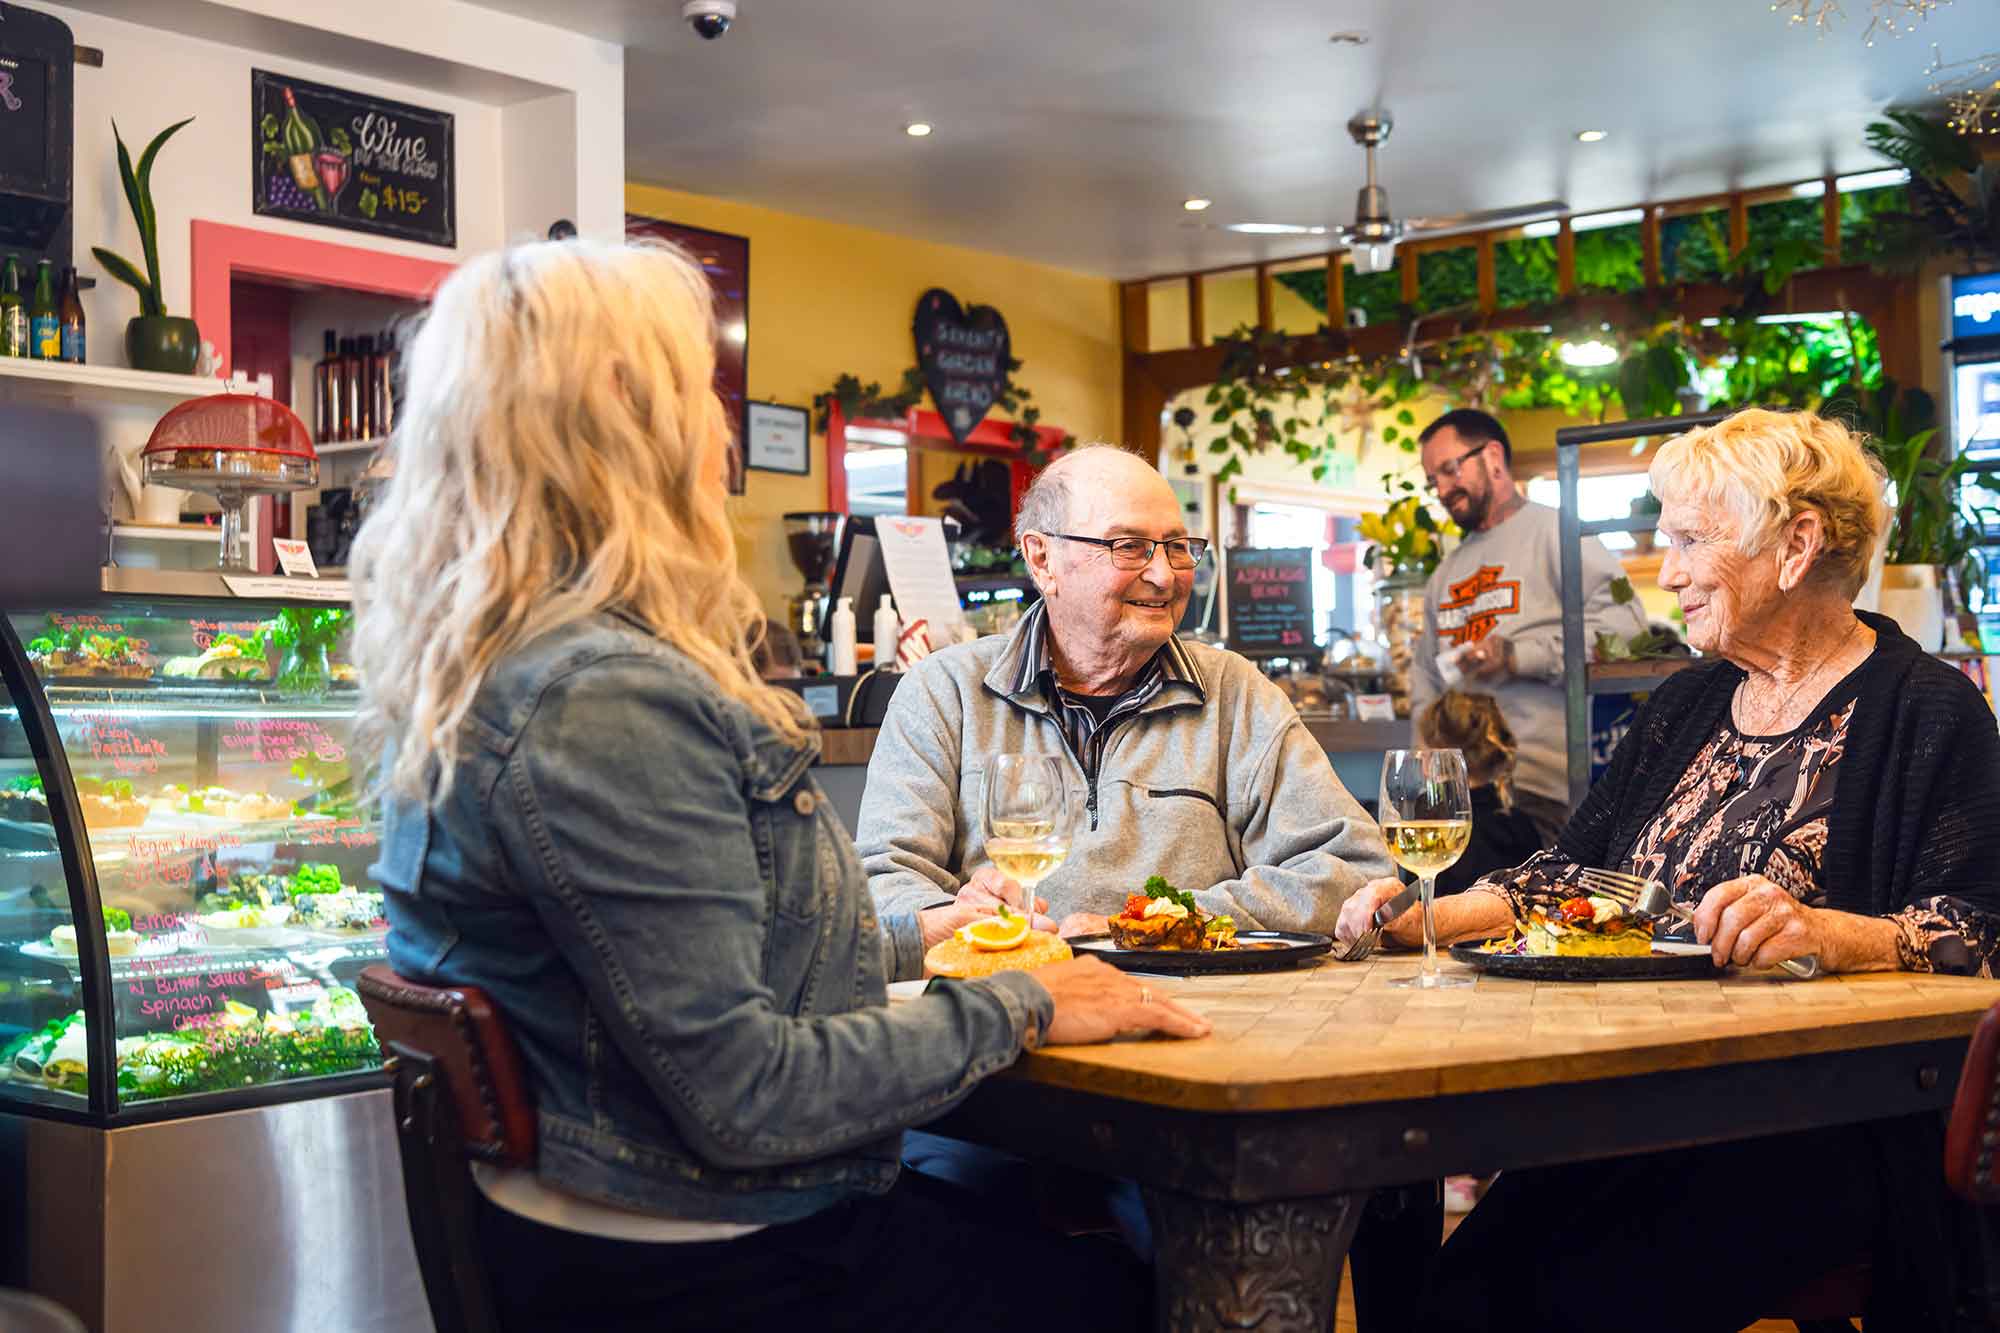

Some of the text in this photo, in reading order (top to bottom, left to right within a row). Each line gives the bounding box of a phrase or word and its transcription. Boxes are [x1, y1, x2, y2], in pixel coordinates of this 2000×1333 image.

[352, 112, 427, 162] Wine
[207, 970, 247, 989] Sauce
[140, 993, 213, 1020] Spinach
